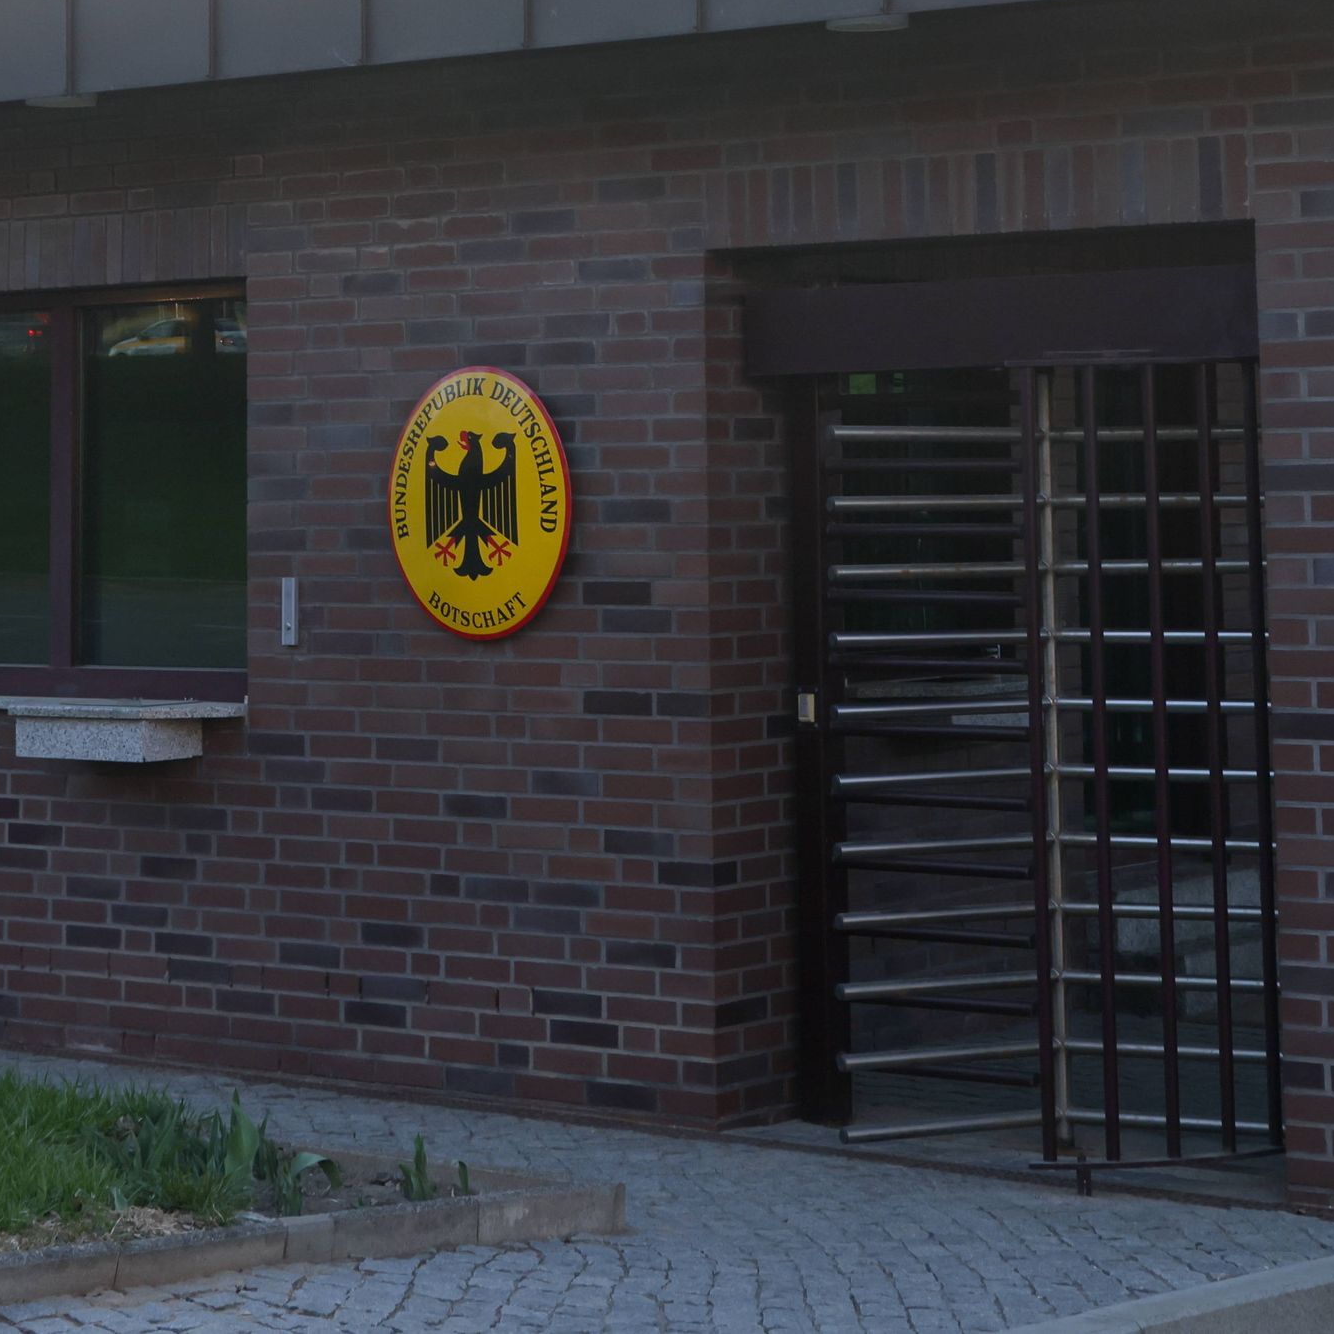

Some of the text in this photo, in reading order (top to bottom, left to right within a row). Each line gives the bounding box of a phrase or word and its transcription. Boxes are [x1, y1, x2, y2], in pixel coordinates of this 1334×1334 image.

[395, 377, 558, 539] BUNDESREPUBLIK DEUTSCHLAND
[428, 590, 527, 629] BOTSCHAFT
